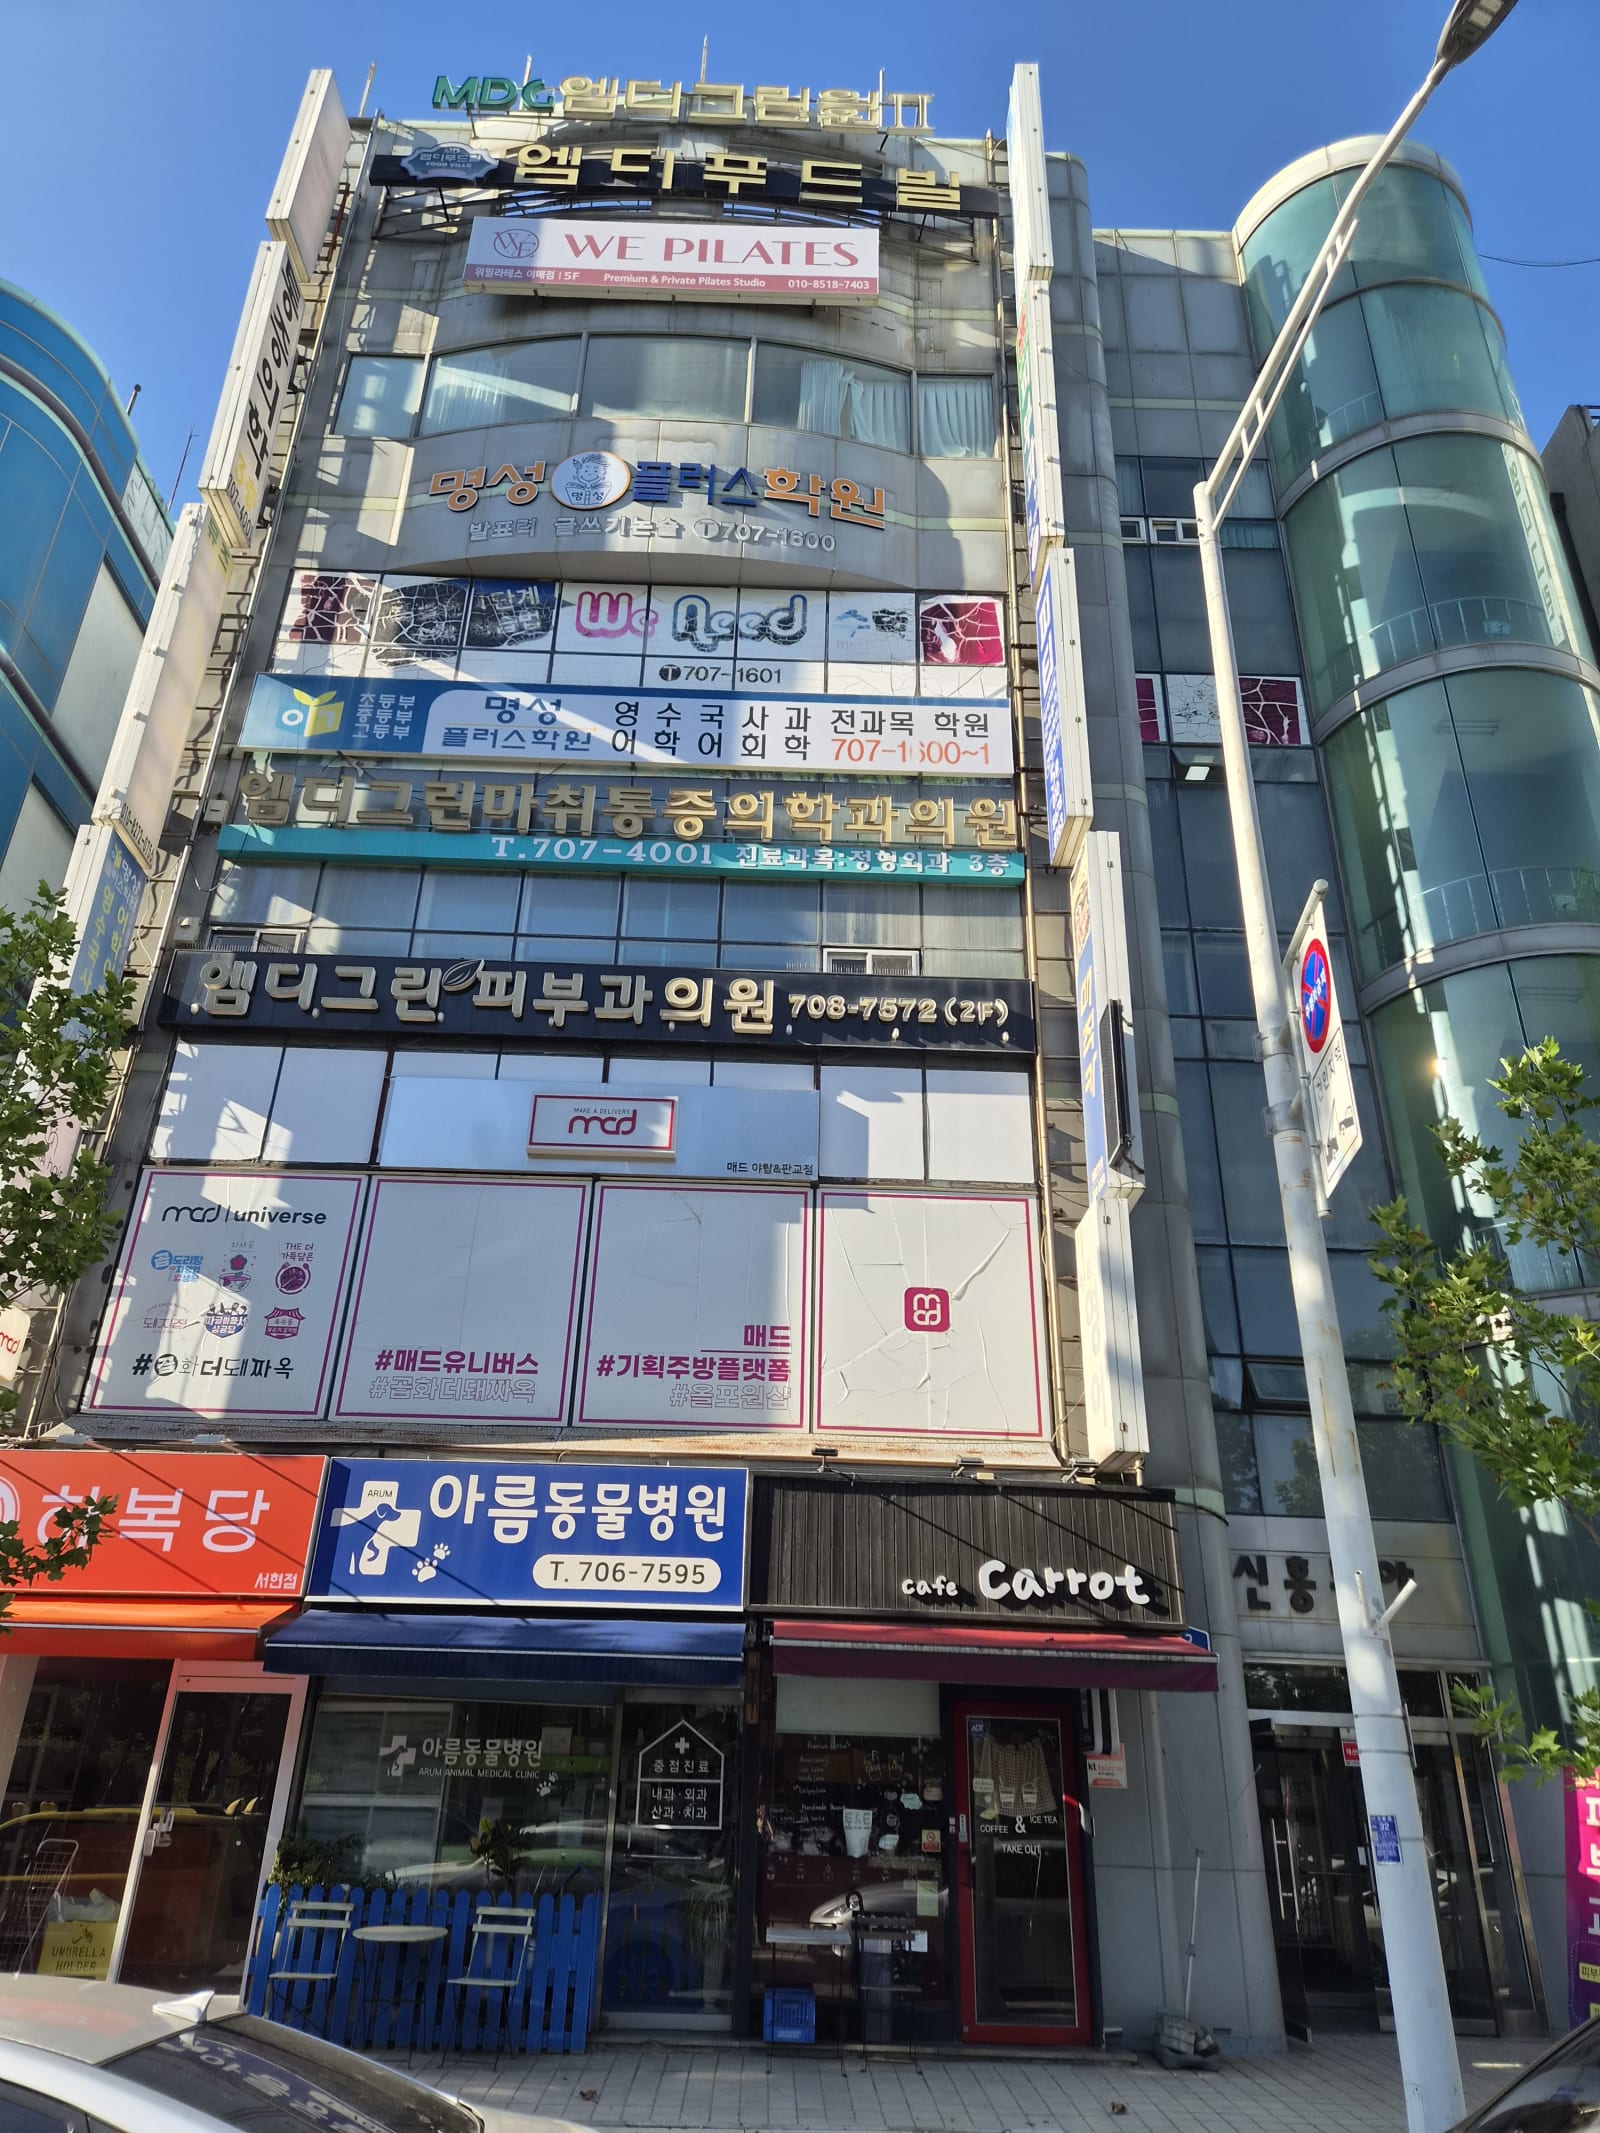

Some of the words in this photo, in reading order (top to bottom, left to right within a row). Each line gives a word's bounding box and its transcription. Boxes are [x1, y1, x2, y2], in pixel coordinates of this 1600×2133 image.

[432, 75, 554, 111] MDG
[514, 144, 960, 211] 엠디푸드빌
[565, 234, 646, 260] WE
[663, 238, 859, 267] PILATES
[475, 267, 523, 279] 위필라테스
[526, 269, 555, 281] 이매점
[603, 273, 648, 284] Premium
[650, 275, 659, 283] &
[660, 275, 697, 285] Private
[698, 276, 732, 287] Pilates
[733, 277, 766, 288] Studio
[787, 279, 870, 290] 010-8518-7403
[429, 461, 546, 511] 명성
[468, 517, 538, 542] 발표력
[359, 692, 416, 710] 초등부
[486, 695, 562, 725] 명성
[355, 708, 413, 725] 중등부
[830, 709, 915, 737] 전과목
[935, 711, 990, 739] 학원
[351, 723, 410, 741] 고등부
[441, 726, 593, 752] 플러스학원
[969, 852, 1010, 876] 3층
[599, 1107, 631, 1115] DELIVERY
[727, 1162, 748, 1173] 매드
[752, 1162, 814, 1176] 야탑&판교점
[233, 1206, 328, 1225] universe
[286, 1242, 303, 1251] THE
[280, 1251, 315, 1262] 가득담은
[743, 1324, 790, 1348] 매드
[375, 1349, 539, 1375] #매드유니버스
[596, 1354, 791, 1382] #기획주방플랫폼
[669, 1383, 792, 1410] #올포원샵
[367, 1489, 394, 1499] ARUM
[430, 1473, 726, 1545] 아름동물병원
[254, 1573, 298, 1590] 서현점
[902, 1575, 959, 1597] cafe
[978, 1559, 1151, 1606] Carrot
[422, 1737, 543, 1768] 아름동물병원
[418, 1767, 443, 1777] ARUM
[444, 1768, 475, 1778] ANIMAL
[477, 1769, 513, 1779] MEDICAL
[514, 1770, 540, 1779] CLINIC
[979, 1824, 1009, 1834] COFFEE
[1029, 1815, 1042, 1825] ICE
[1043, 1815, 1058, 1825] TEA
[1002, 1843, 1024, 1855] TAKE
[1025, 1844, 1042, 1856] OUT
[51, 1946, 106, 1960] UMBRELLA
[55, 1961, 97, 1973] HOLDER
